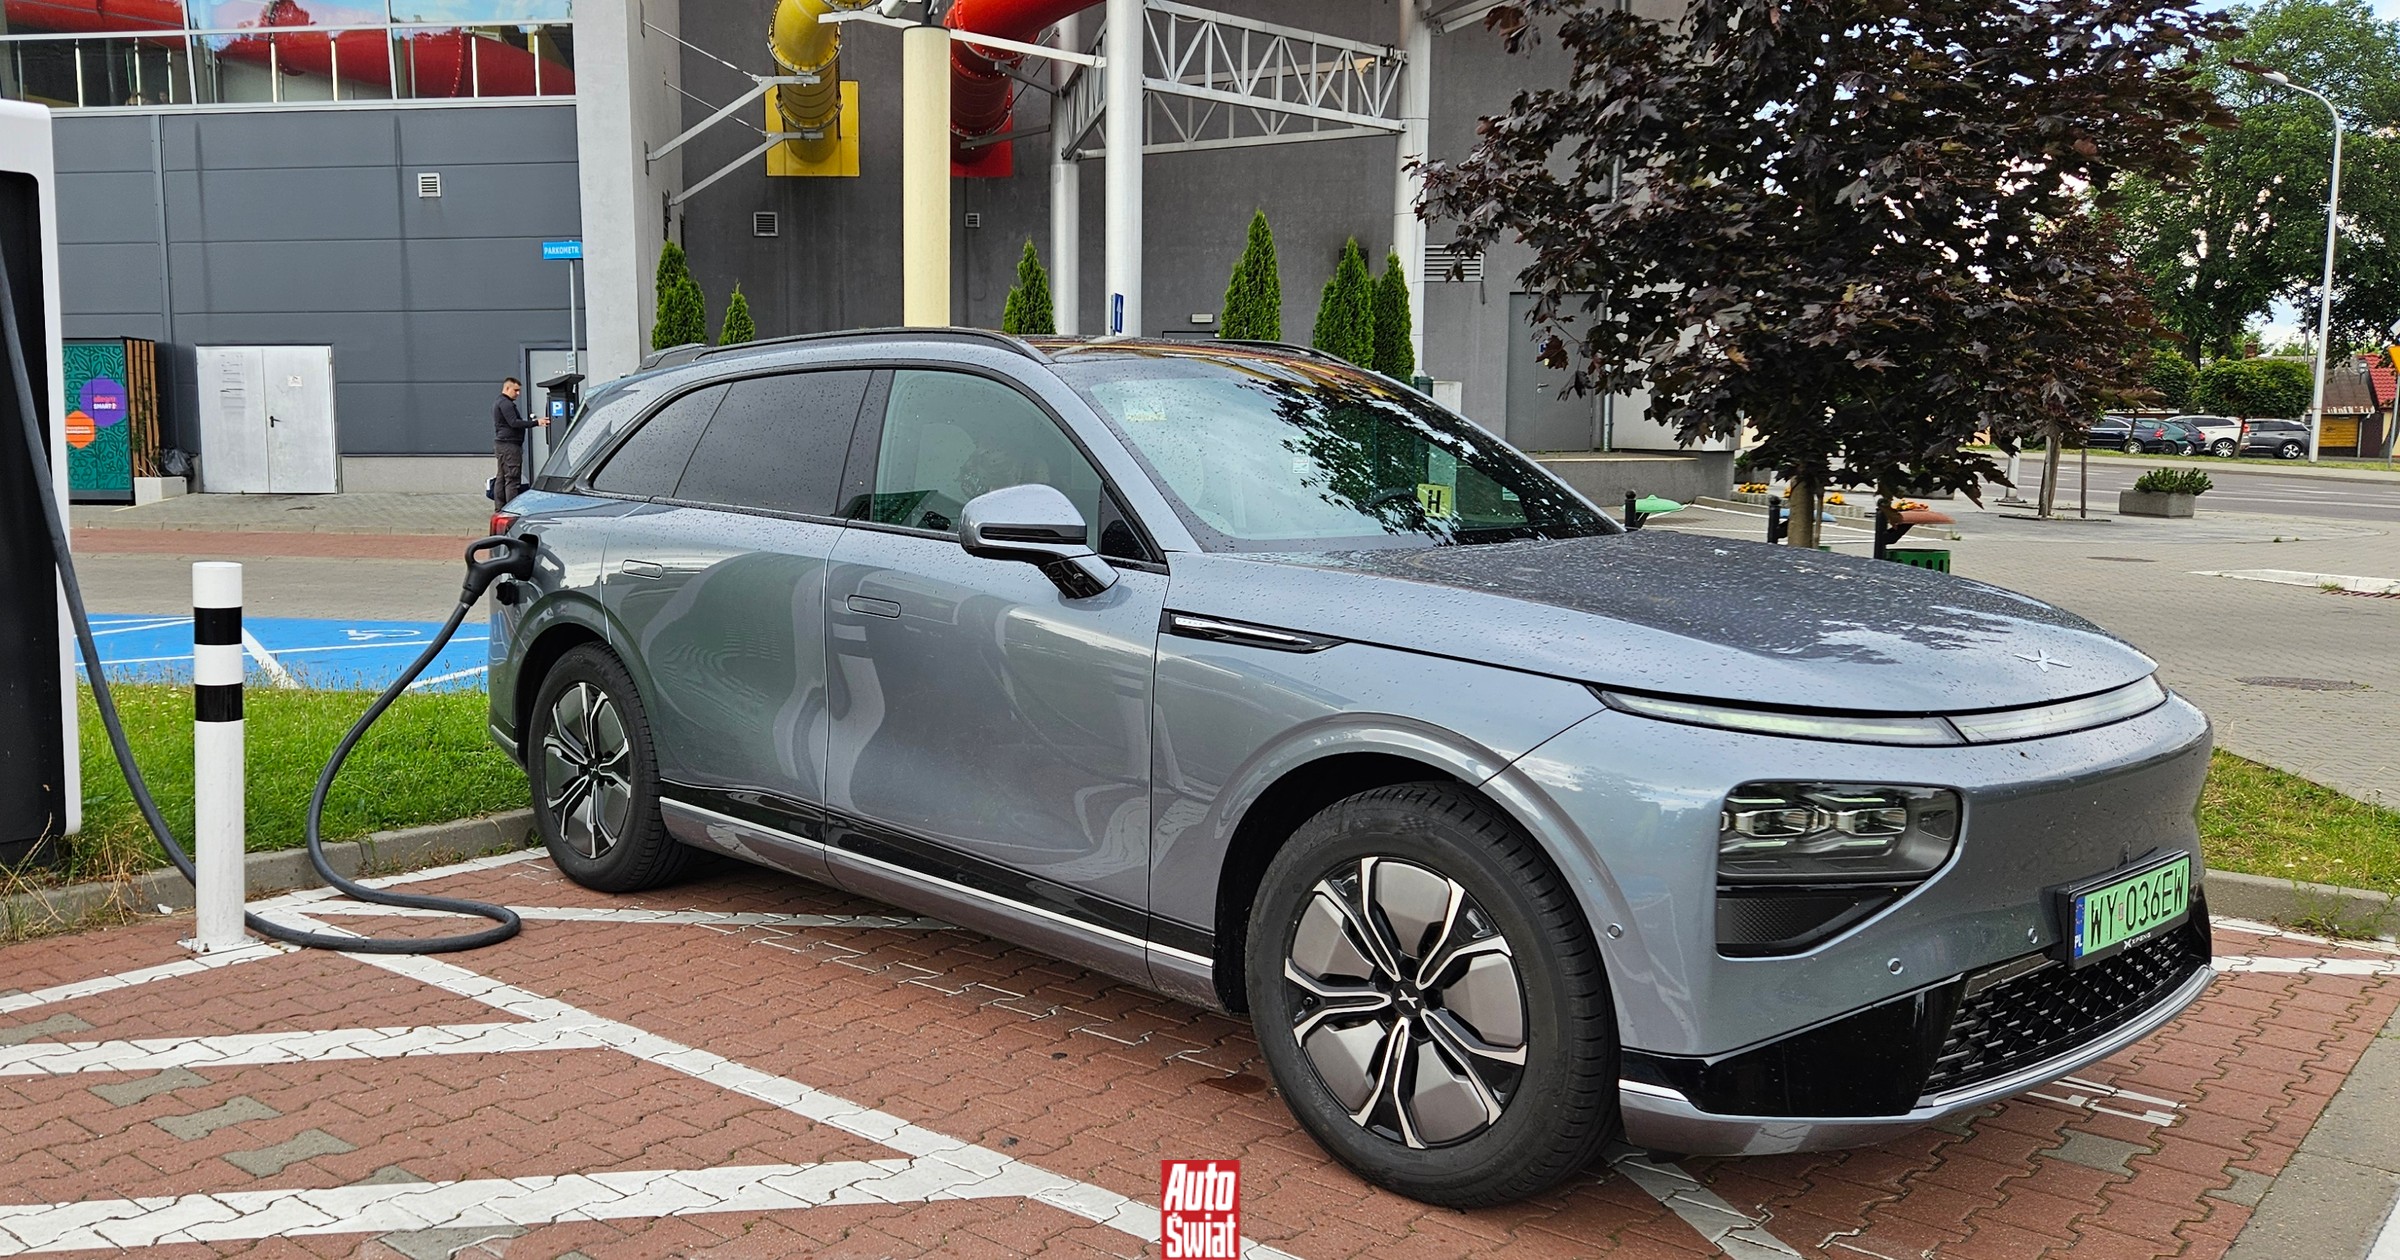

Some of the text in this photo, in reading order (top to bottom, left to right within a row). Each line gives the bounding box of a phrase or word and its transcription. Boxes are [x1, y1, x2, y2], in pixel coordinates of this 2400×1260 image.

[544, 246, 579, 254] PARKOMETR
[552, 402, 562, 414] P
[1427, 490, 1442, 513] H
[2090, 865, 2185, 948] WY 036EW
[2074, 934, 2083, 949] PL
